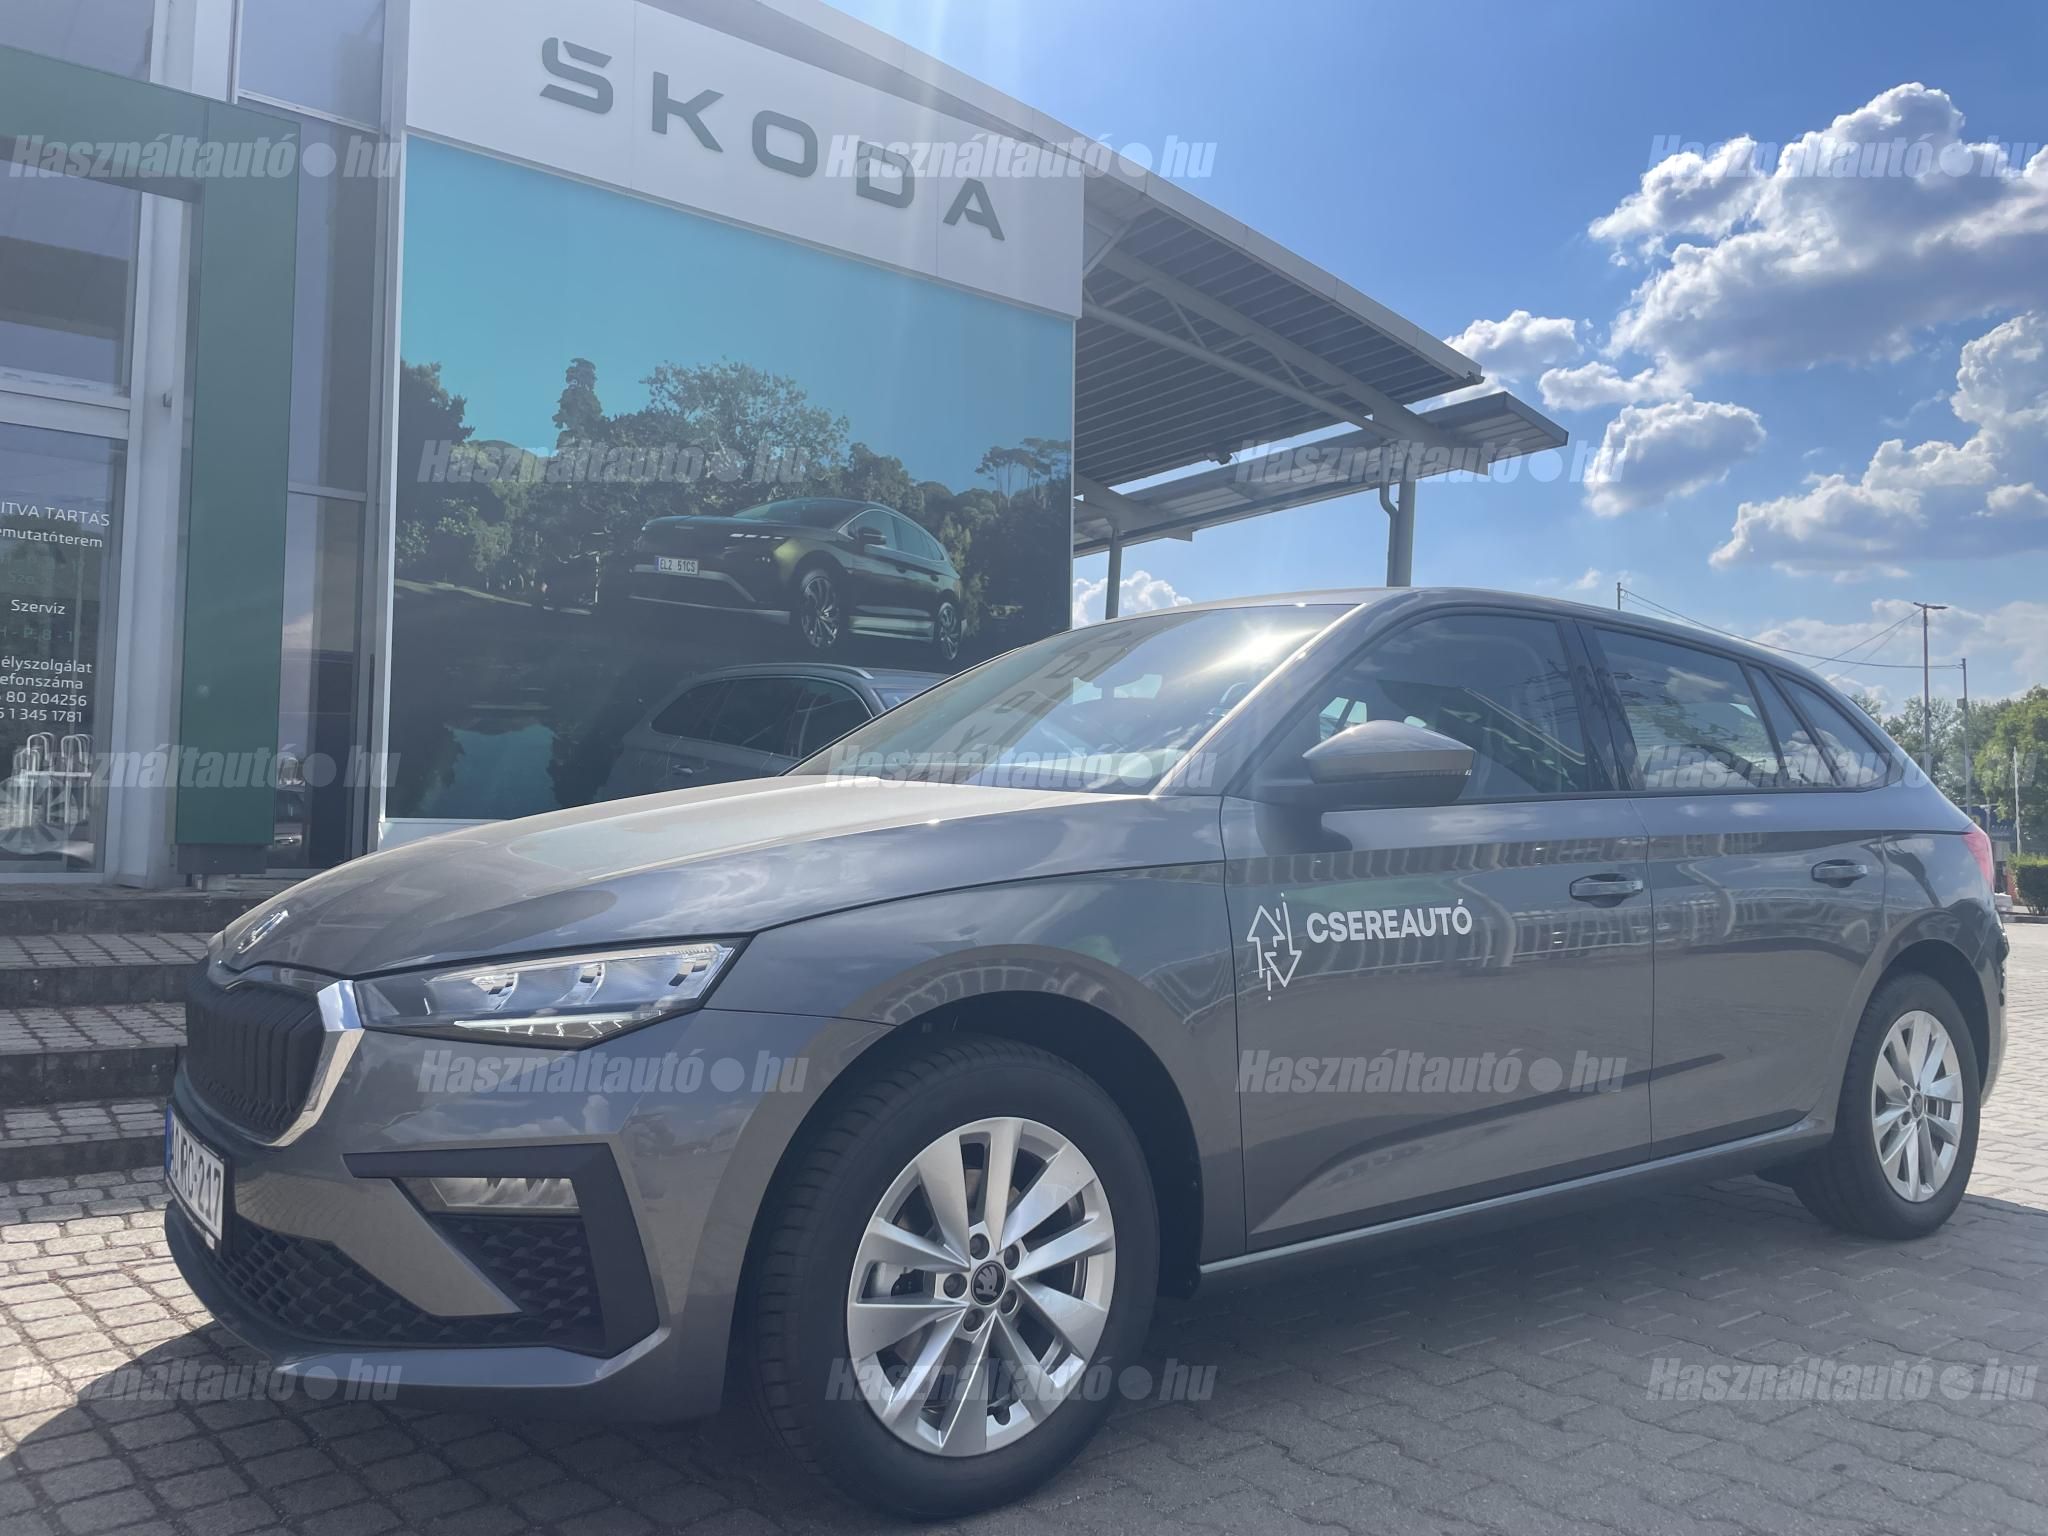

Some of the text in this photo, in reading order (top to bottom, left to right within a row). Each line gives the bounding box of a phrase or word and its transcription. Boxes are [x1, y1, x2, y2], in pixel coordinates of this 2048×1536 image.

[44, 506, 110, 527] TARTÁS
[0, 528, 103, 547] mutatóterem
[6, 691, 26, 703] 80
[31, 692, 88, 707] 204256
[20, 708, 48, 721] 345
[51, 710, 83, 723] 1781
[1307, 898, 1473, 943] CSEREAUTÓ
